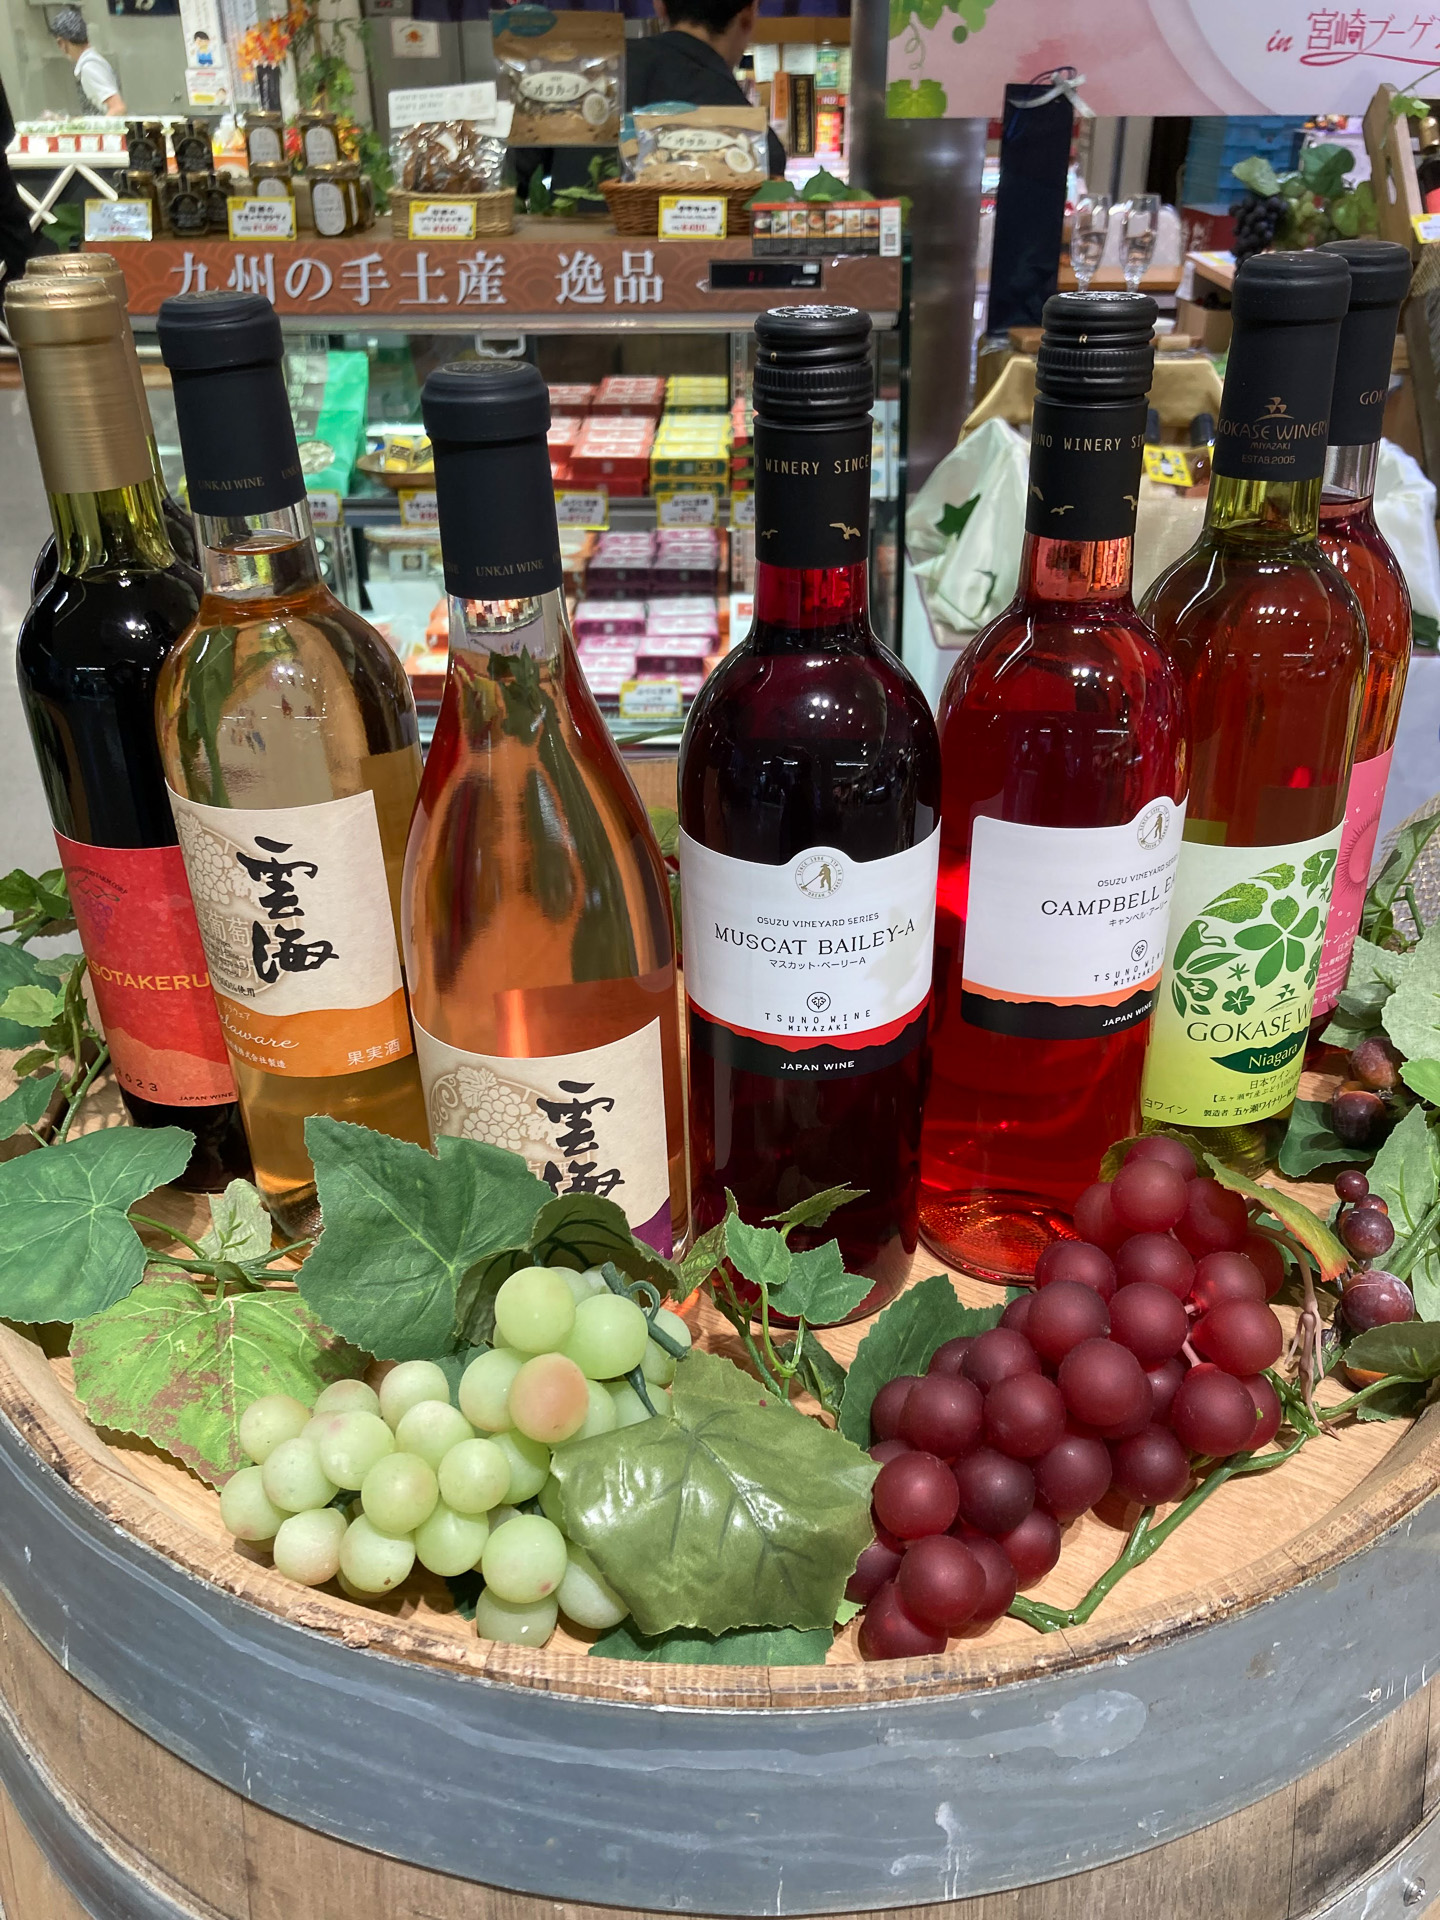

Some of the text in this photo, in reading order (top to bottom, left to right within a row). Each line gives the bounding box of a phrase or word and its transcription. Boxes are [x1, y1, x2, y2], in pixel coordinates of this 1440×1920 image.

[1266, 29, 1293, 52] in
[1306, 8, 1440, 51] 宮崎ブーゲ
[170, 249, 665, 305] 九州の手土産 逸品
[1219, 418, 1270, 440] GOKASE
[1064, 437, 1121, 452] WINERY
[1251, 442, 1291, 450] MIYAZAKI
[765, 458, 820, 475] WINERY
[834, 454, 870, 474] SINCE
[233, 476, 265, 489] WINE
[475, 565, 514, 577] UNKAI
[516, 559, 544, 573] WINE
[1097, 876, 1127, 888] OSUZU
[1129, 864, 1165, 883] VINEYARD
[236, 835, 340, 984] 雲海
[1041, 886, 1160, 916] CAMPBELL
[757, 912, 880, 928] OSUZU VINEYARD SERIES
[714, 918, 916, 956] MUSCAT BAILEY-A
[88, 958, 209, 991] SOTAKERU
[1094, 965, 1139, 983] TSUNO
[1113, 965, 1155, 987] MIYAZAKI
[764, 1008, 872, 1024] TSUNO WINE
[1102, 1000, 1152, 1027] JAPAN WINE
[219, 1014, 300, 1049] elaware
[788, 1023, 849, 1032] MIYAZAKI
[1187, 1012, 1292, 1043] GOKASE
[347, 1038, 401, 1067] 果実酒
[1248, 1044, 1298, 1069] Niagara
[780, 1060, 856, 1072] JAPAN WINE
[117, 1067, 158, 1092] 2023
[1249, 1070, 1292, 1090] 日本ワイン
[179, 1091, 236, 1102] JAPAN WINE
[1203, 1108, 1229, 1118] 製造者
